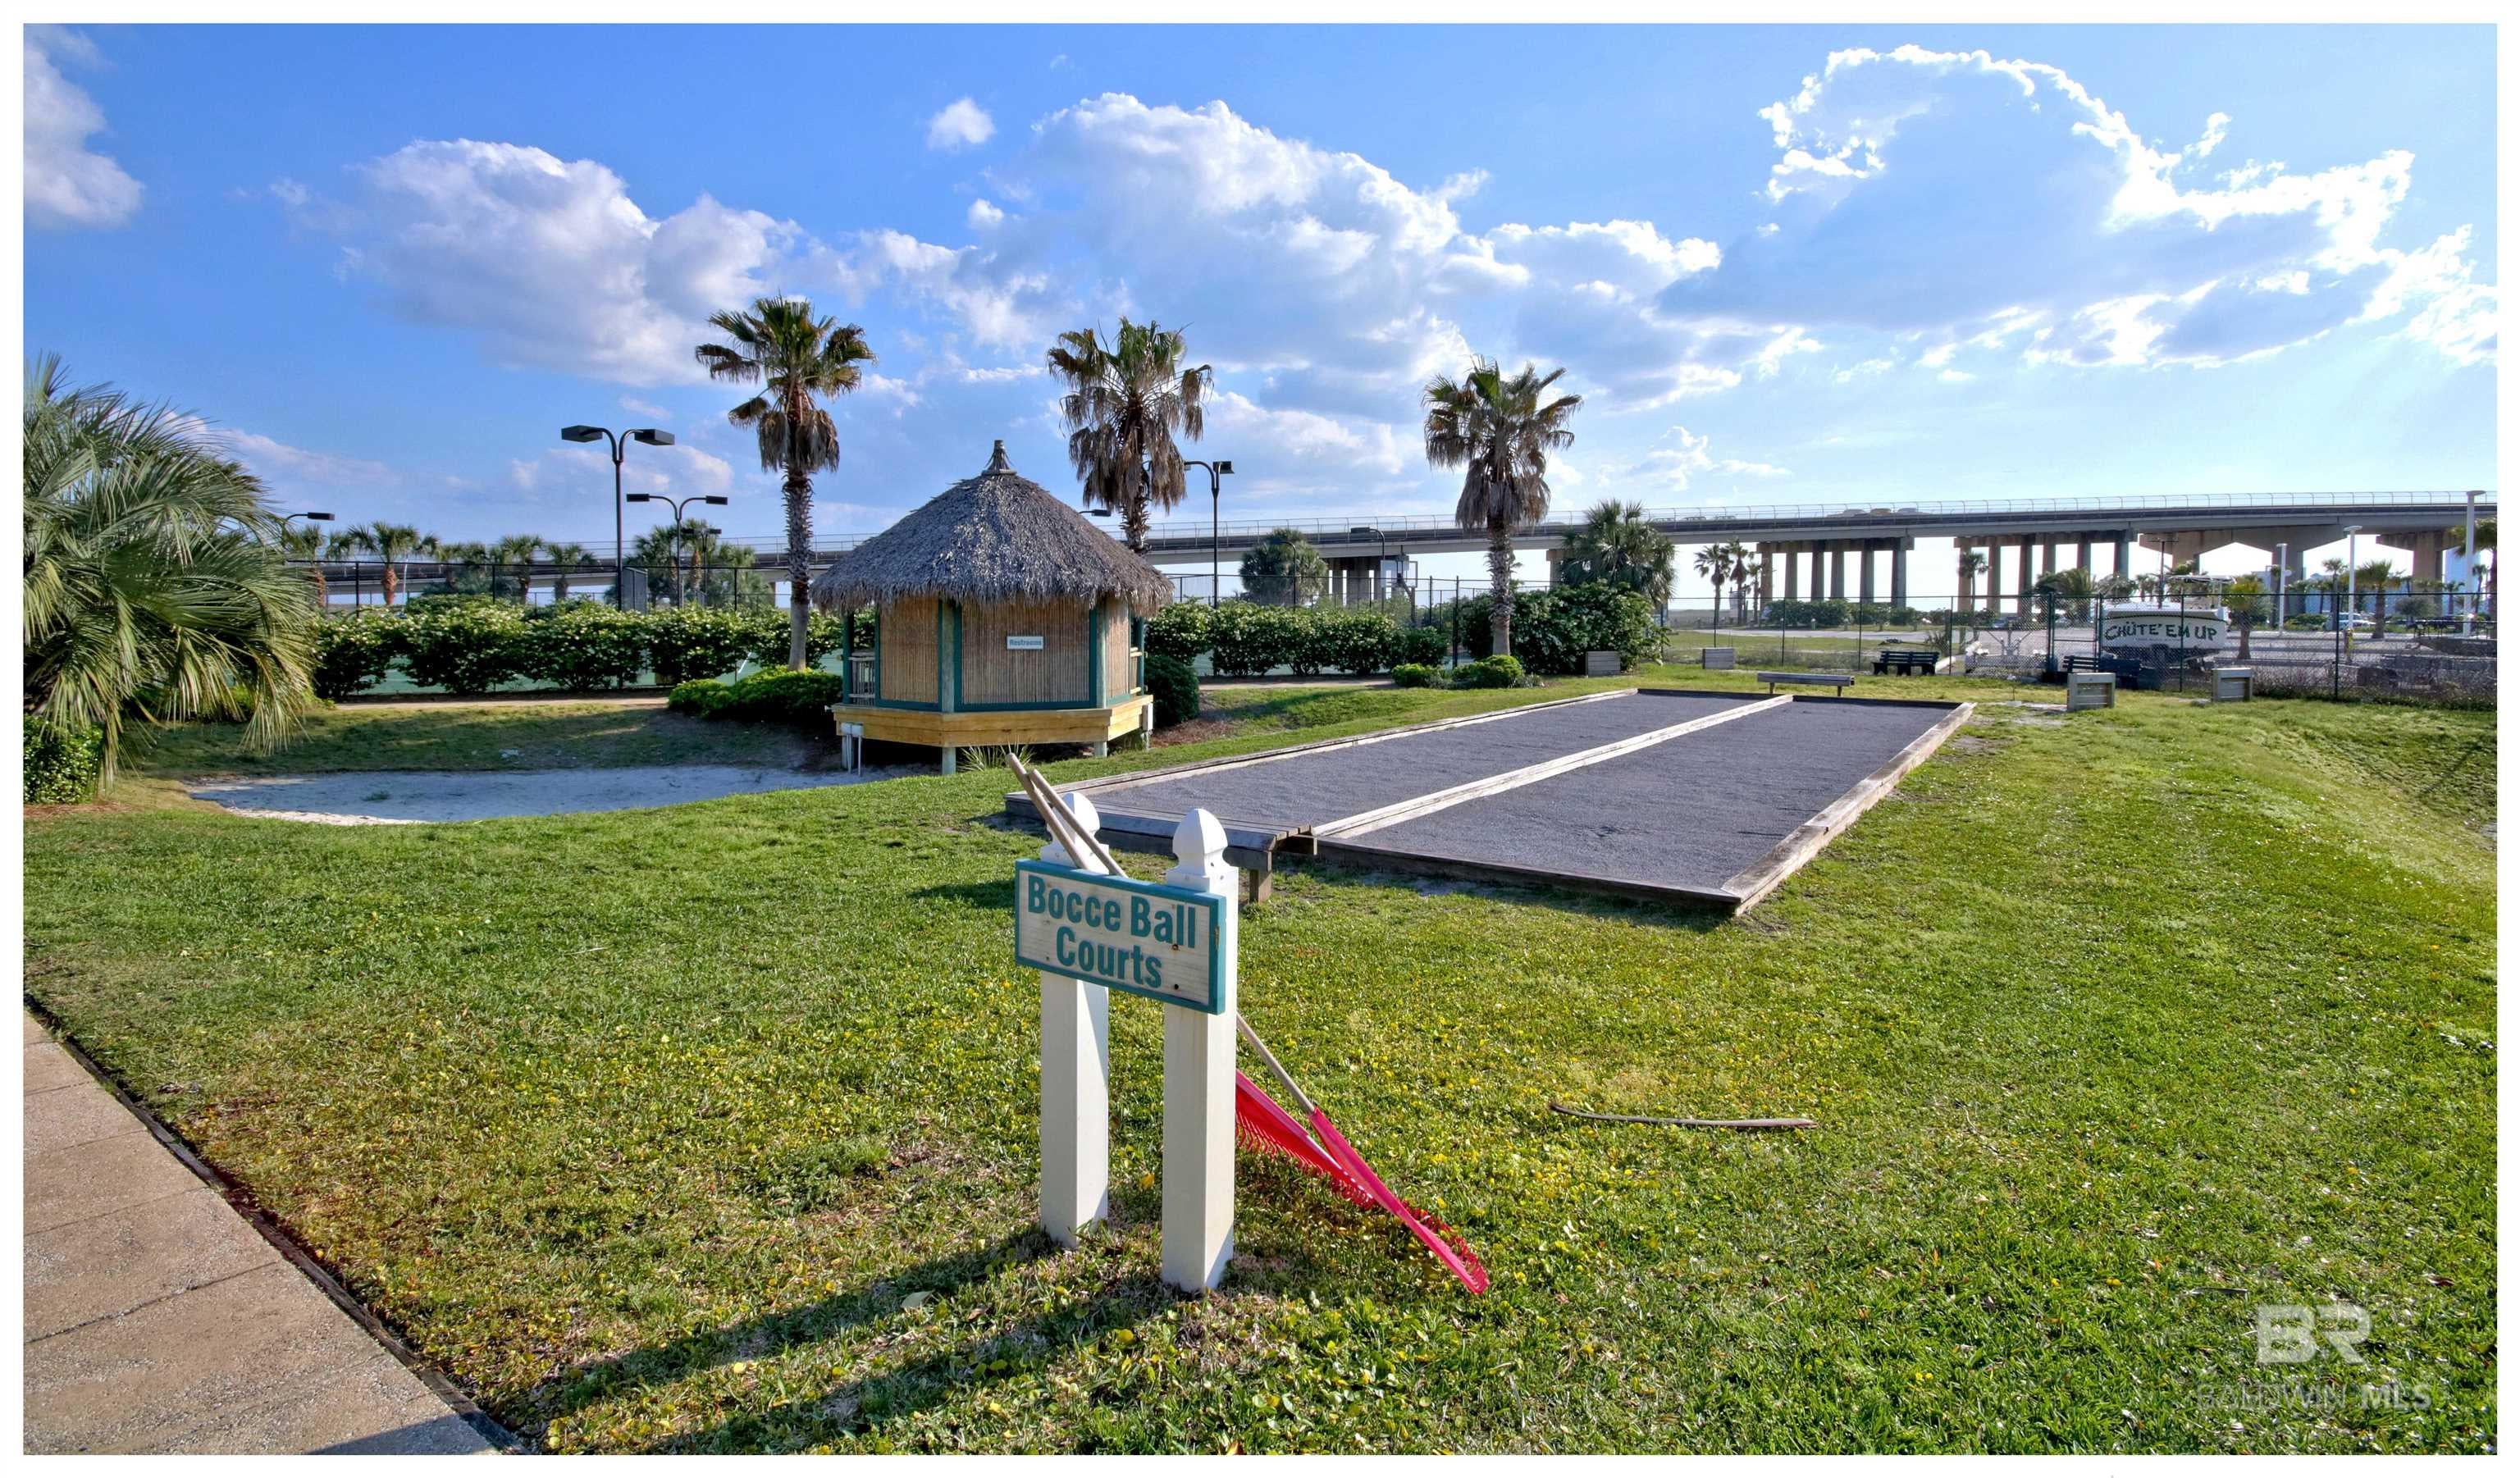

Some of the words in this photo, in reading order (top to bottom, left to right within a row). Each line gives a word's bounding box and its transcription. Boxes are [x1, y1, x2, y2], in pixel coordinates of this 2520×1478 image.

[2194, 626, 2217, 641] UP
[1028, 875, 1121, 932] Bocce
[1130, 895, 1196, 948] Ball
[1056, 926, 1162, 988] Courts
